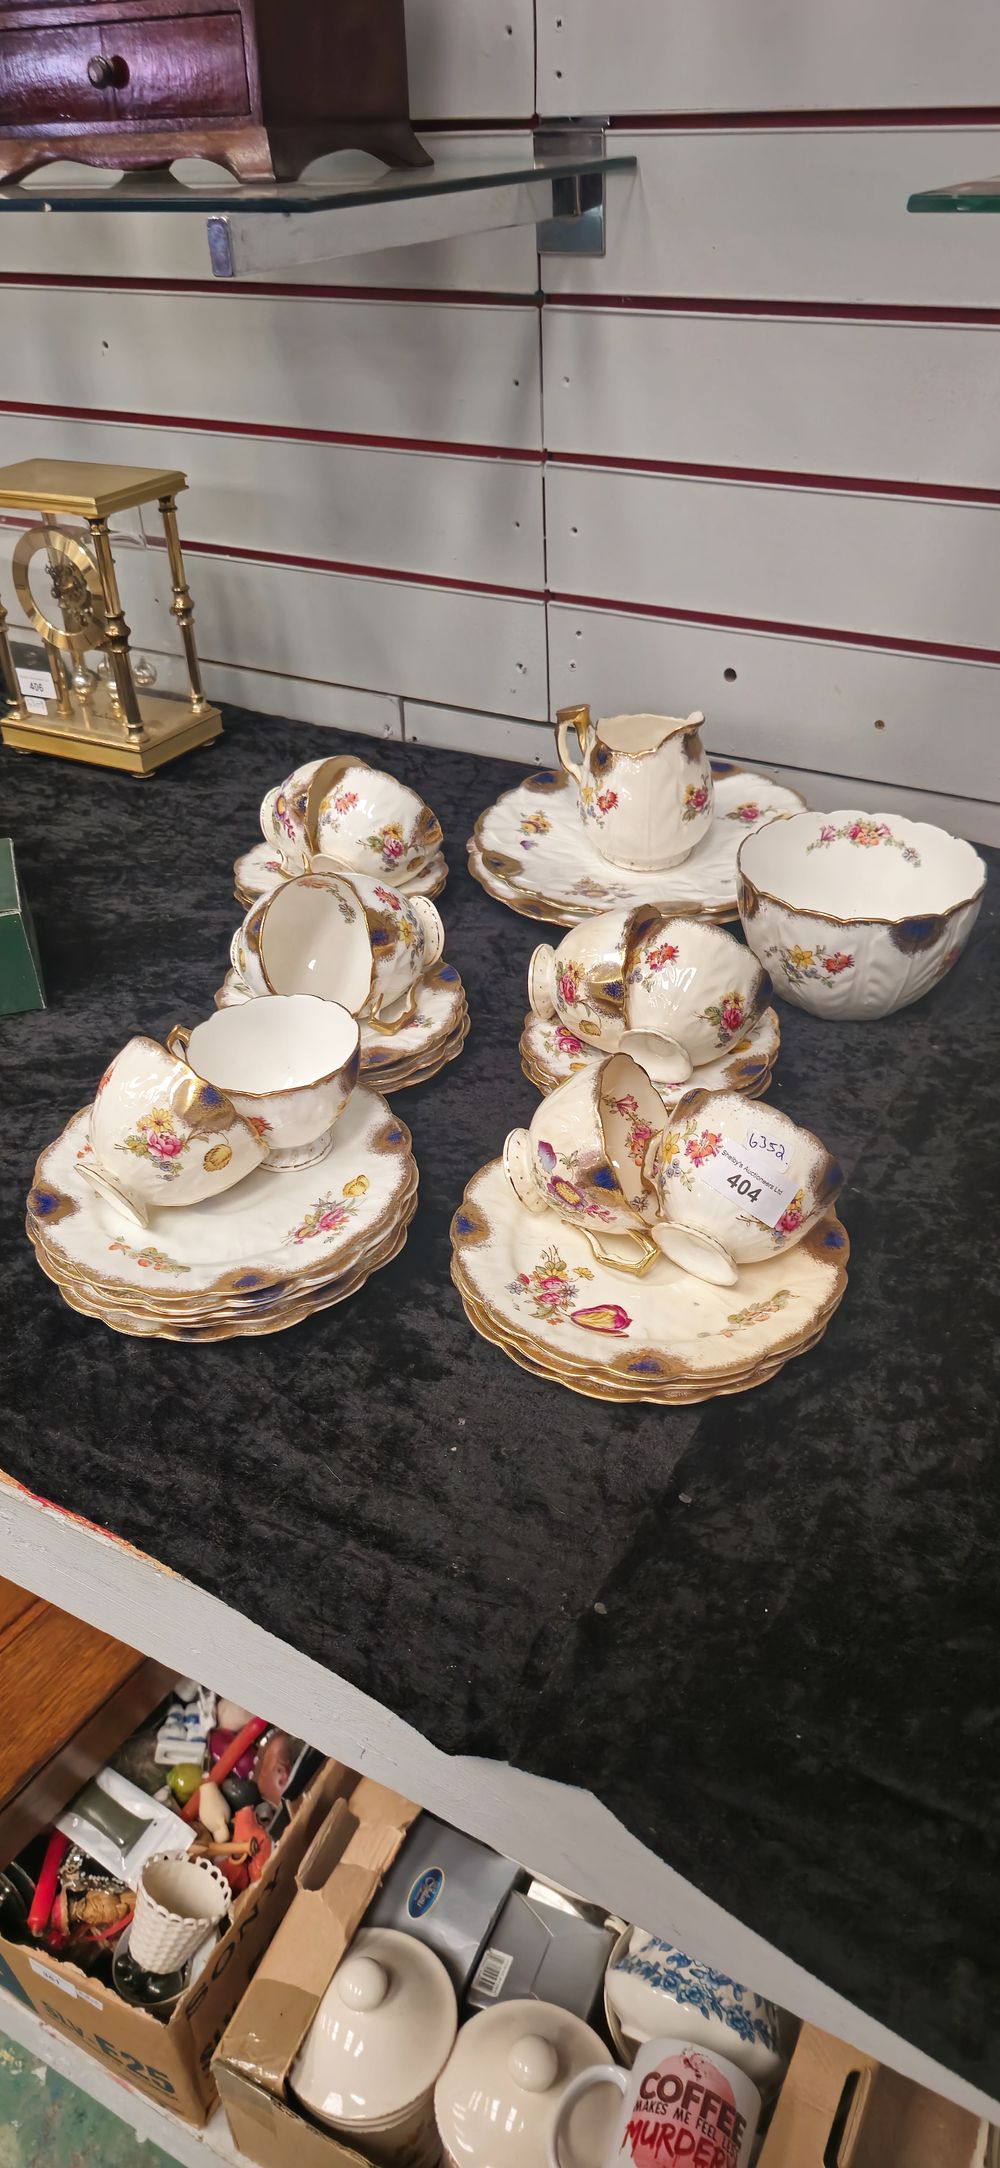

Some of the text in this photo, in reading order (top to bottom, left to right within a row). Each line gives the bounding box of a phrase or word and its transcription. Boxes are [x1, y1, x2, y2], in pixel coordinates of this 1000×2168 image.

[748, 1132, 785, 1161] 6352
[721, 1149, 783, 1196] Shelby's Auctioneers Ltd
[726, 1174, 762, 1203] 404
[633, 2099, 669, 2116] MAKES
[673, 2107, 692, 2126] ME
[695, 2118, 717, 2141] FEEL
[639, 2071, 747, 2149] COFFEE
